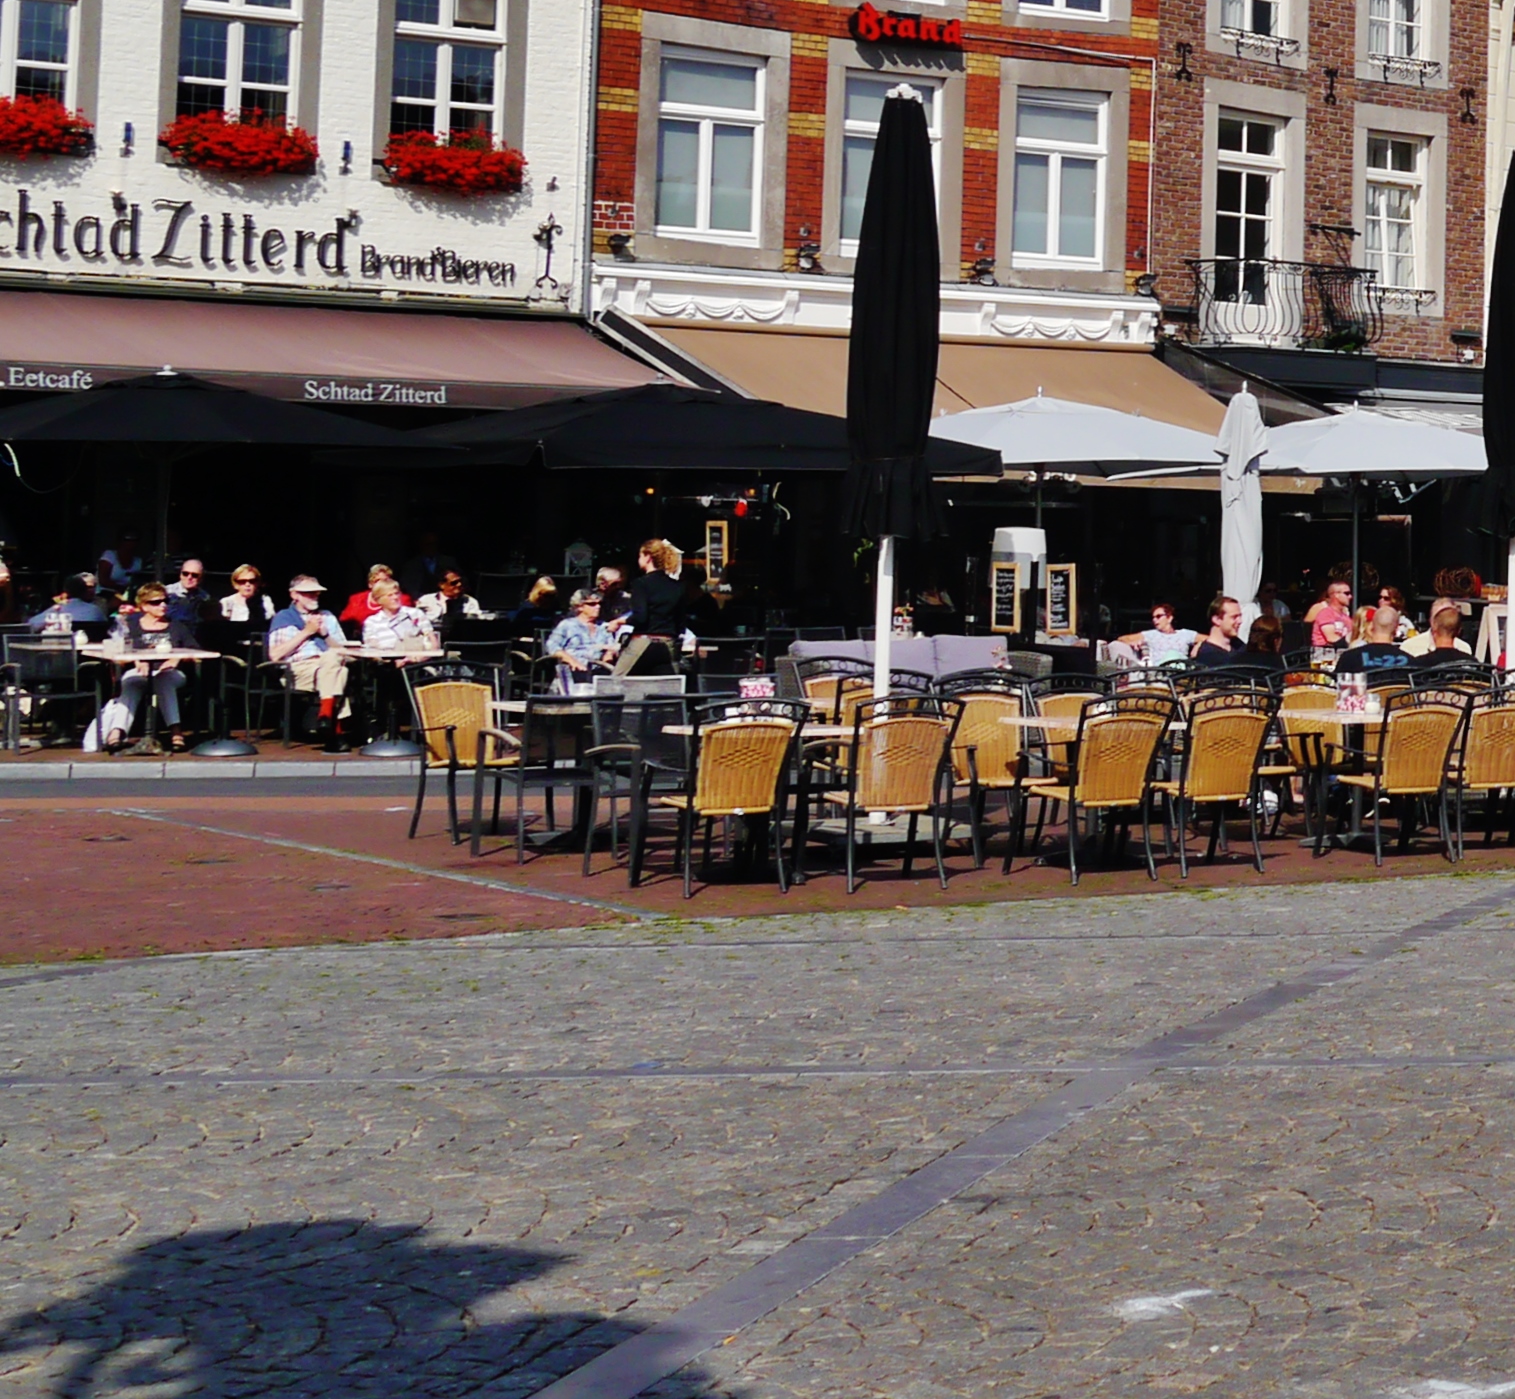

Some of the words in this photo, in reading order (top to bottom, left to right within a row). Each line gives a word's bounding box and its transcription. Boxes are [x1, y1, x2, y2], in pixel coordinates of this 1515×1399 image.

[858, 1, 962, 45] Brand
[151, 198, 347, 271] Zitterd
[9, 367, 93, 391] Eetcafé
[304, 380, 373, 402] Schtad
[379, 383, 447, 404] Zitterd
